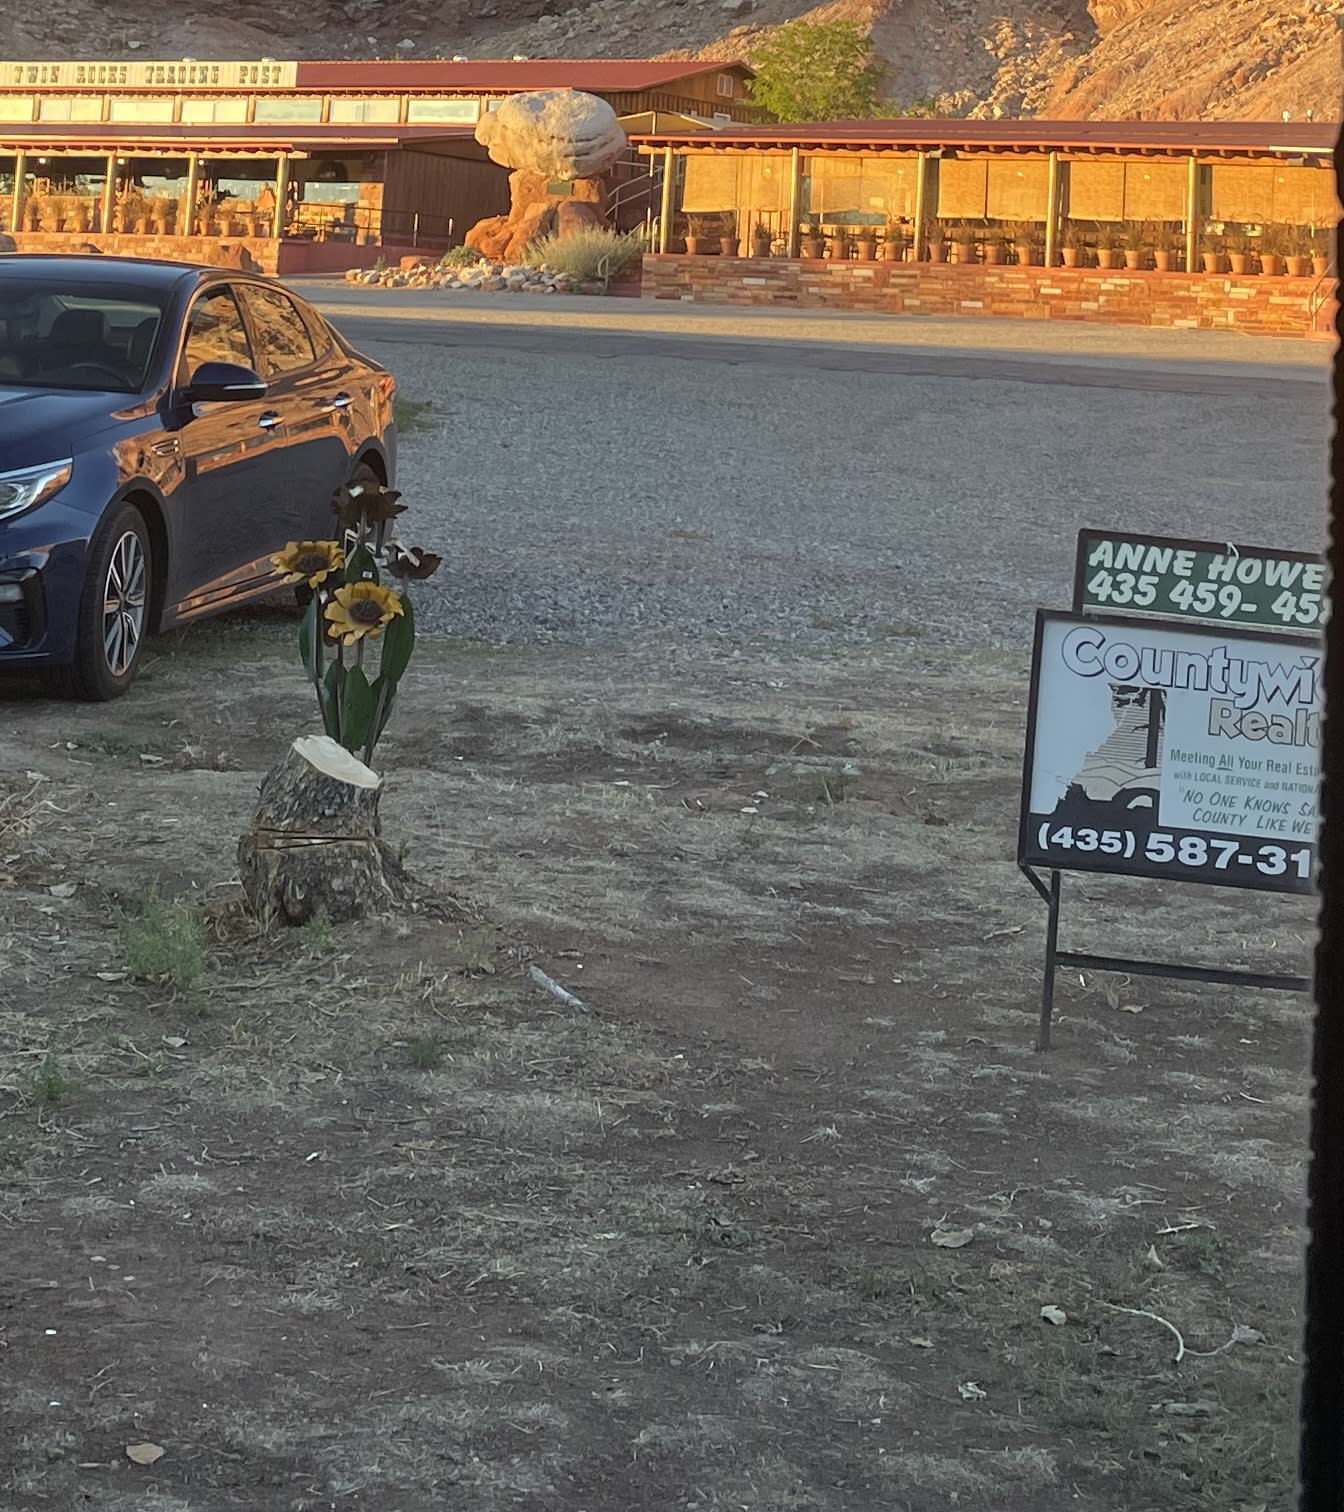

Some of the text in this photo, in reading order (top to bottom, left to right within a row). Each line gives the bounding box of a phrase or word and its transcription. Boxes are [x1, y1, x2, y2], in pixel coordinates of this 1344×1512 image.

[13, 65, 283, 85] TWIN ROCKS TRADING POST
[1088, 540, 1197, 577] ANNE
[1087, 569, 1160, 606] 435
[1168, 579, 1258, 618] 459-
[1060, 625, 1324, 710] Countywi
[1170, 748, 1216, 769] Meeting
[1218, 753, 1234, 769] All
[1238, 756, 1264, 771] Your
[1266, 759, 1293, 775] Real
[1173, 770, 1193, 781] with
[1194, 772, 1222, 785] LOCAL
[1224, 775, 1263, 789] SERVICE
[1263, 780, 1280, 791] and
[1209, 791, 1239, 808] ONE
[1244, 795, 1293, 815] KNOWS
[1298, 801, 1319, 818] SA
[1192, 806, 1314, 835] COUNTY LIKE WE
[1037, 822, 1313, 879] (435) 587-31
